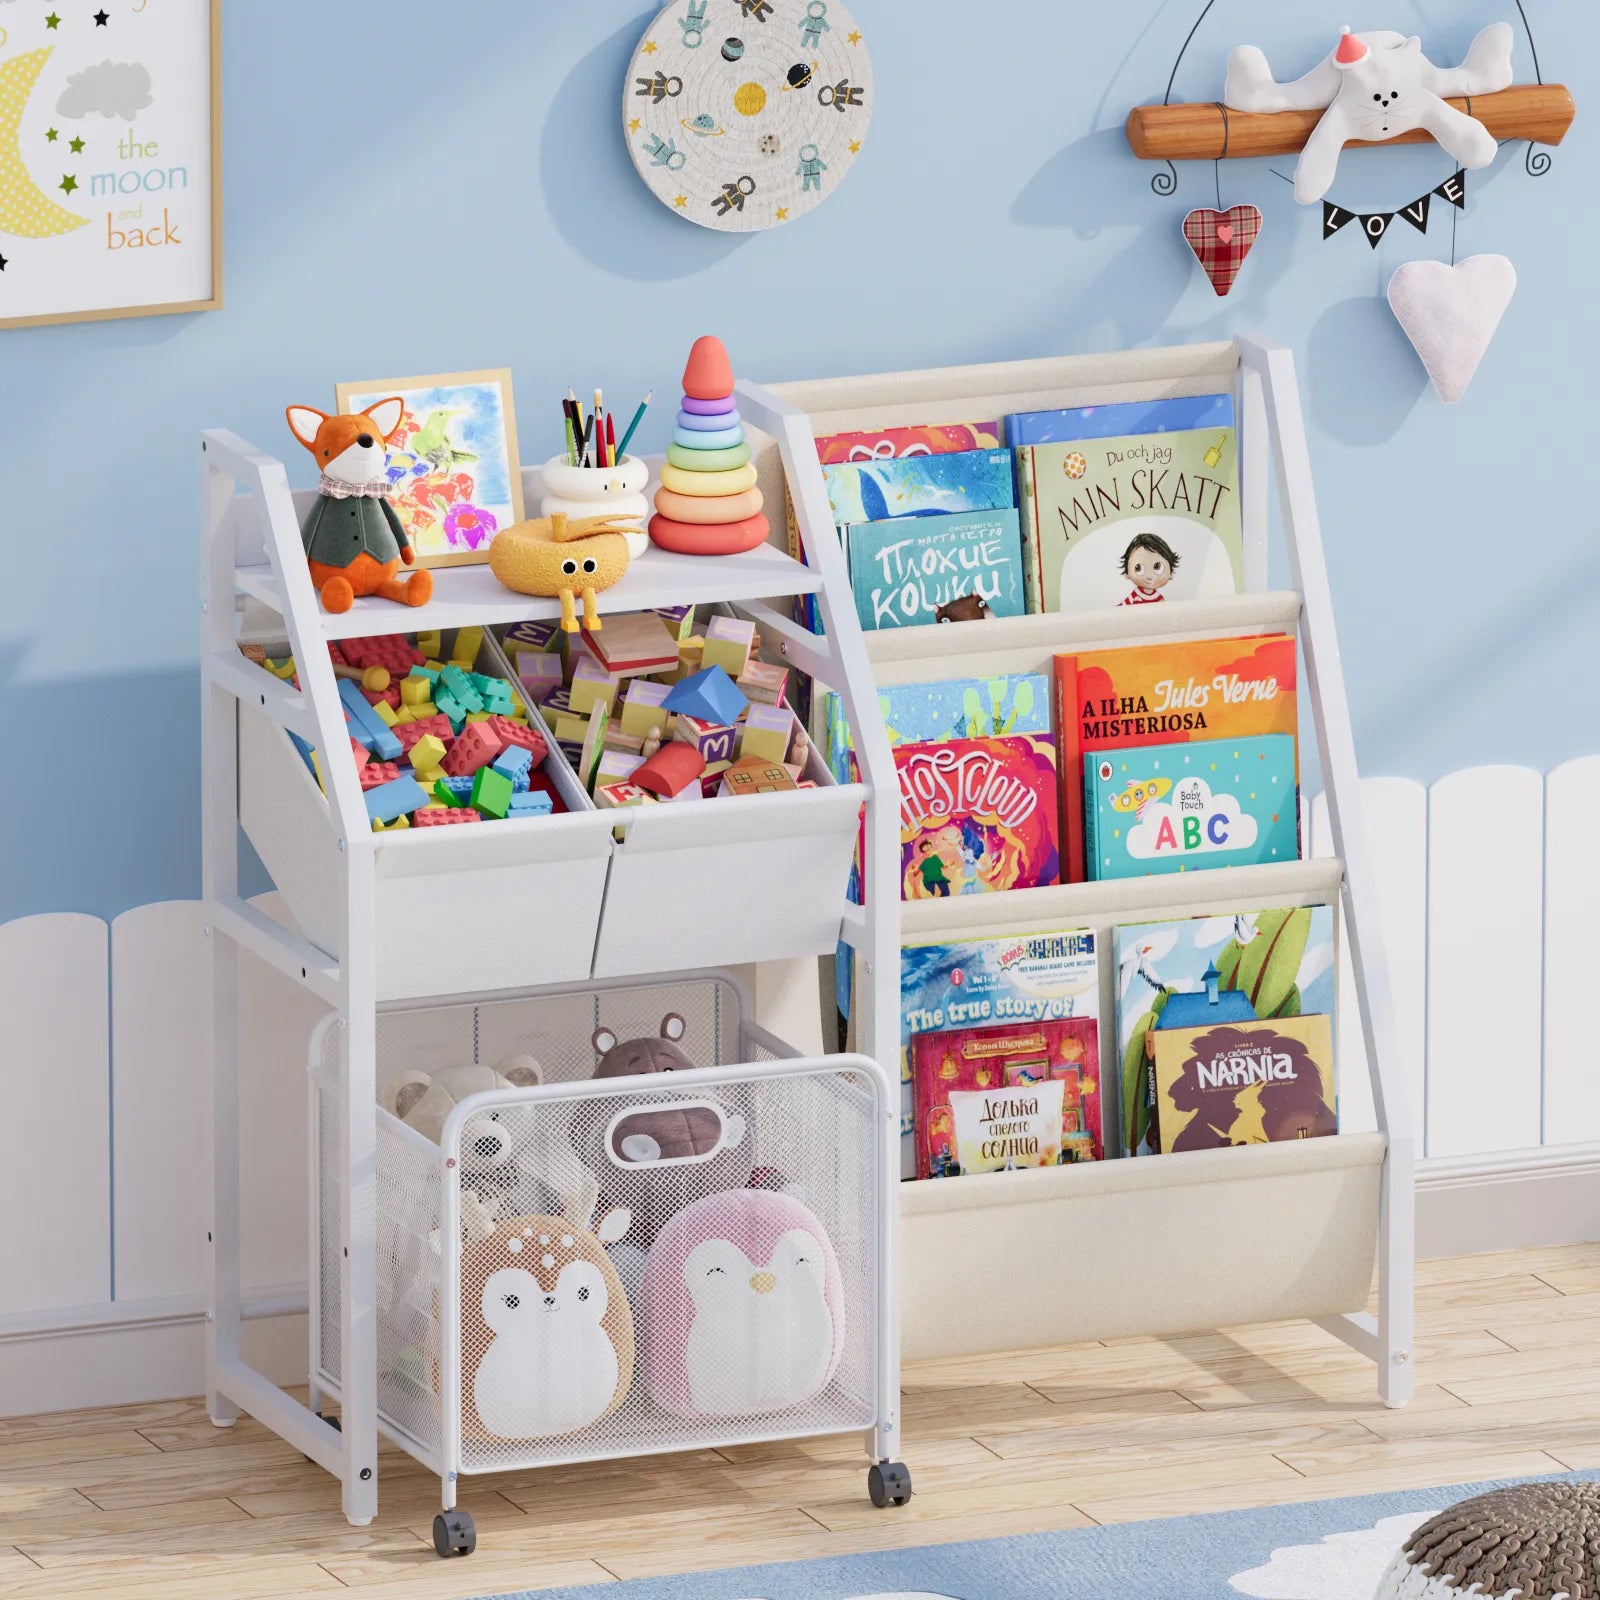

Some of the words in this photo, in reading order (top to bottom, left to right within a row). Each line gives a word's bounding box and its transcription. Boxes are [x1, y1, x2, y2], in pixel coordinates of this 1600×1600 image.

[118, 128, 158, 159] the
[91, 166, 188, 196] moon
[118, 203, 143, 221] and
[1326, 178, 1463, 236] LOVE
[107, 207, 182, 250] back
[1106, 451, 1124, 467] Du
[1127, 445, 1149, 460] och
[1148, 444, 1172, 465] jag
[1057, 477, 1121, 541] MIN
[1131, 469, 1231, 520] SKATT
[1082, 700, 1095, 719] A
[1101, 695, 1149, 717] ILHA
[1154, 677, 1210, 713] Jules
[1212, 673, 1279, 705] Verne
[1083, 712, 1207, 740] MISTERIOSA
[703, 734, 730, 762] M
[900, 749, 1038, 834] HOSTCLOUD
[1180, 799, 1204, 811] Touch
[1181, 790, 1201, 802] Baby
[1155, 813, 1230, 850] ABC
[1001, 944, 1025, 966] BONUS
[907, 1007, 945, 1032] The
[947, 1001, 991, 1023] true
[994, 998, 1048, 1021] story
[1051, 997, 1075, 1018] of
[1215, 1052, 1225, 1060] AS
[1227, 1048, 1262, 1058] CRÔNICAS
[1263, 1046, 1273, 1055] DE
[980, 1097, 1040, 1125] Долька
